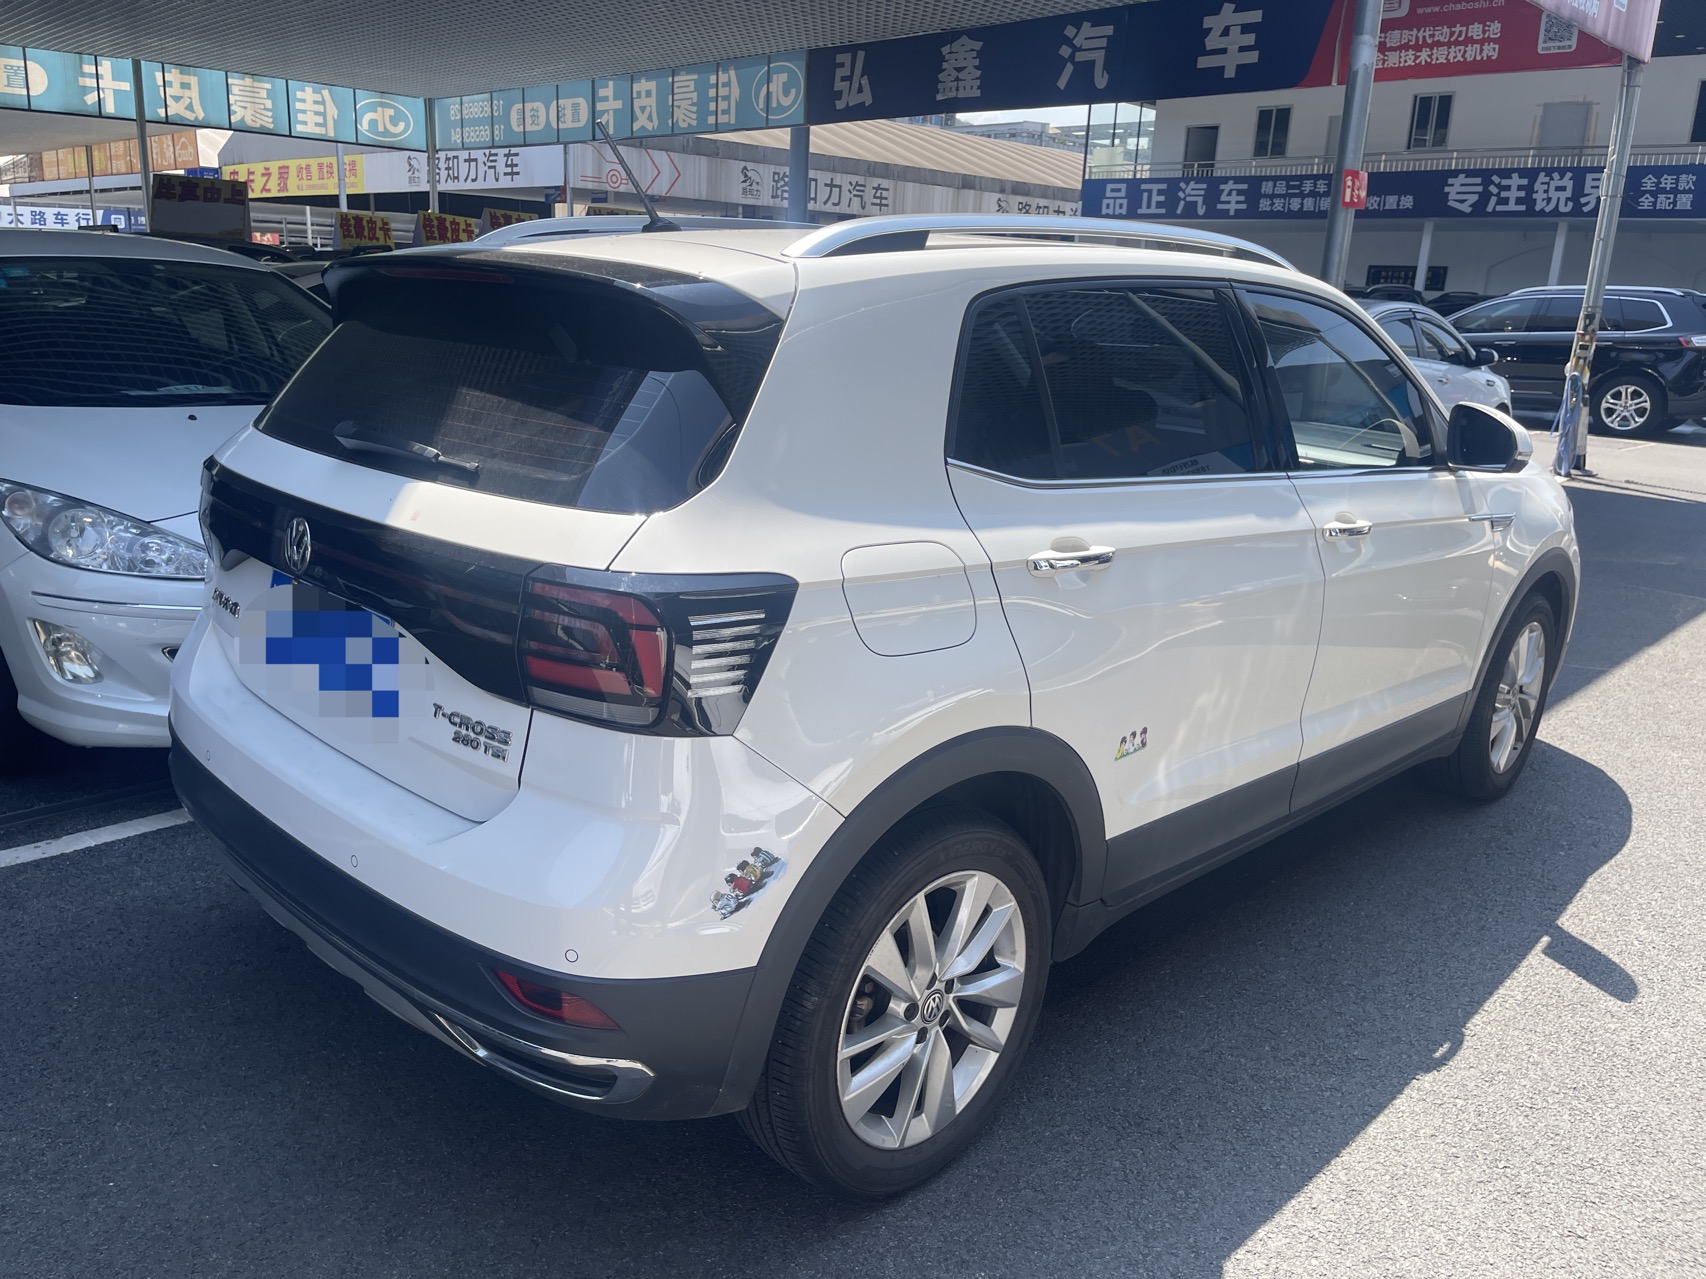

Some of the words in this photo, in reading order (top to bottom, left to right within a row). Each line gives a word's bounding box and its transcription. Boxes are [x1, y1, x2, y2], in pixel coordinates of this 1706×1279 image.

[833, 3, 1263, 110] 弘鑫汽车
[1261, 180, 1329, 195] 精品二手车
[1640, 174, 1697, 191] 全年款
[1101, 180, 1249, 216] 品正汽车
[1637, 194, 1694, 211] 全配置
[0, 210, 92, 227] 大路车行
[433, 702, 513, 746] T-CROSS
[452, 730, 481, 750] 280
[483, 741, 509, 762] TSI
